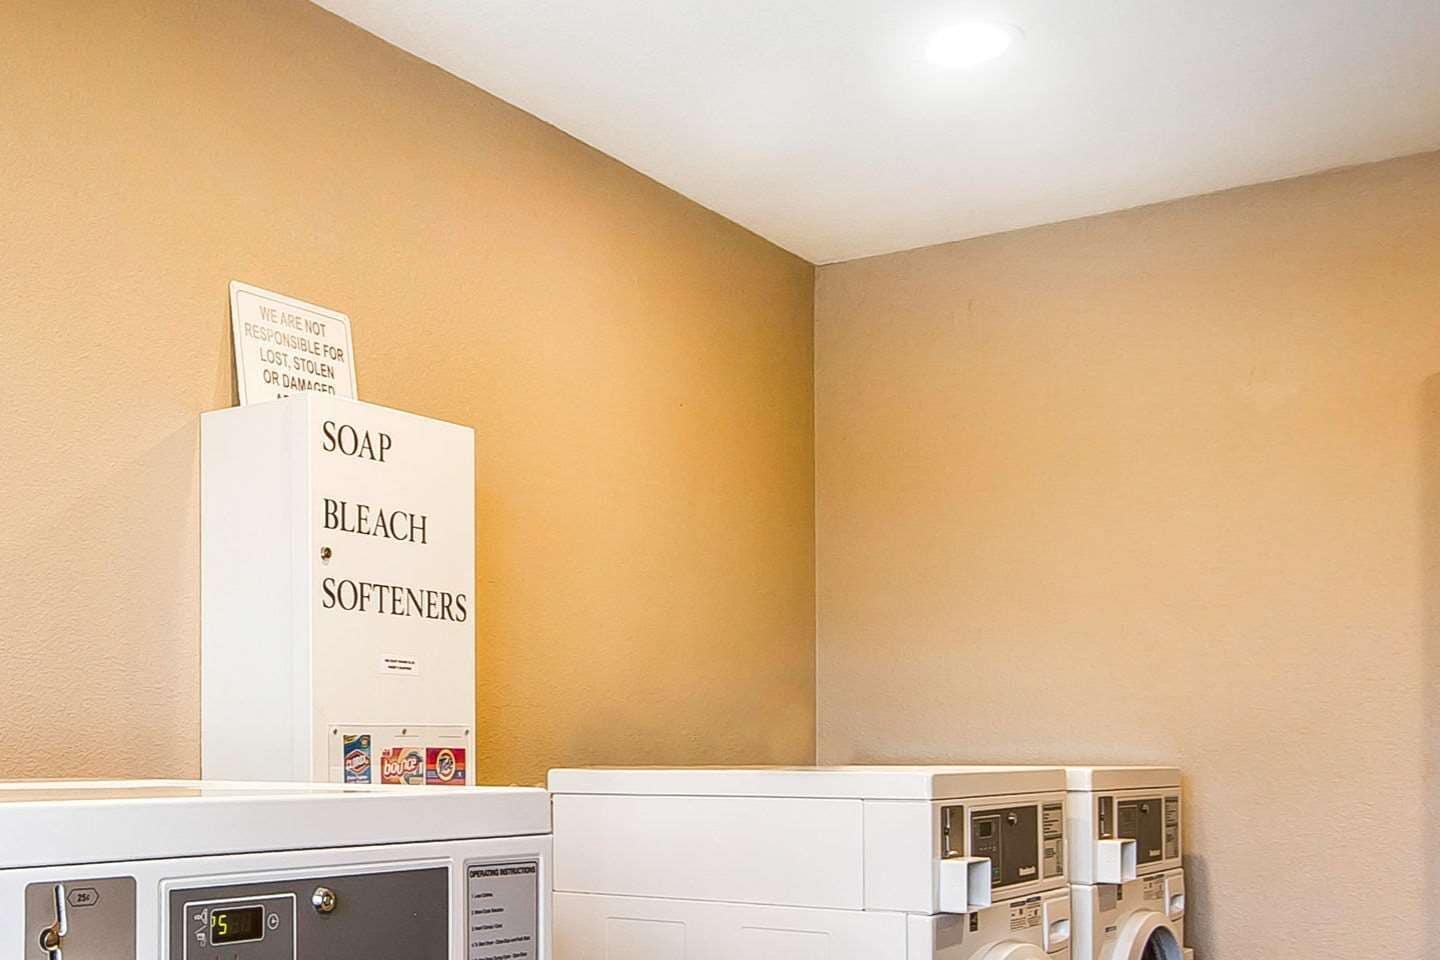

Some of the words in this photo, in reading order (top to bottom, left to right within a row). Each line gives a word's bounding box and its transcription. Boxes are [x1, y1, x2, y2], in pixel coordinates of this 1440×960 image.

[259, 306, 278, 323] WE
[280, 312, 303, 331] ARE
[304, 320, 326, 337] NOT
[244, 322, 321, 356] RESPONSIBLE
[323, 344, 344, 362] FOR
[263, 369, 280, 386] OR
[293, 356, 335, 379] STOLEN
[322, 420, 392, 462] SOAP
[323, 498, 428, 545] BLEACH
[322, 577, 467, 623] SOFTENERS
